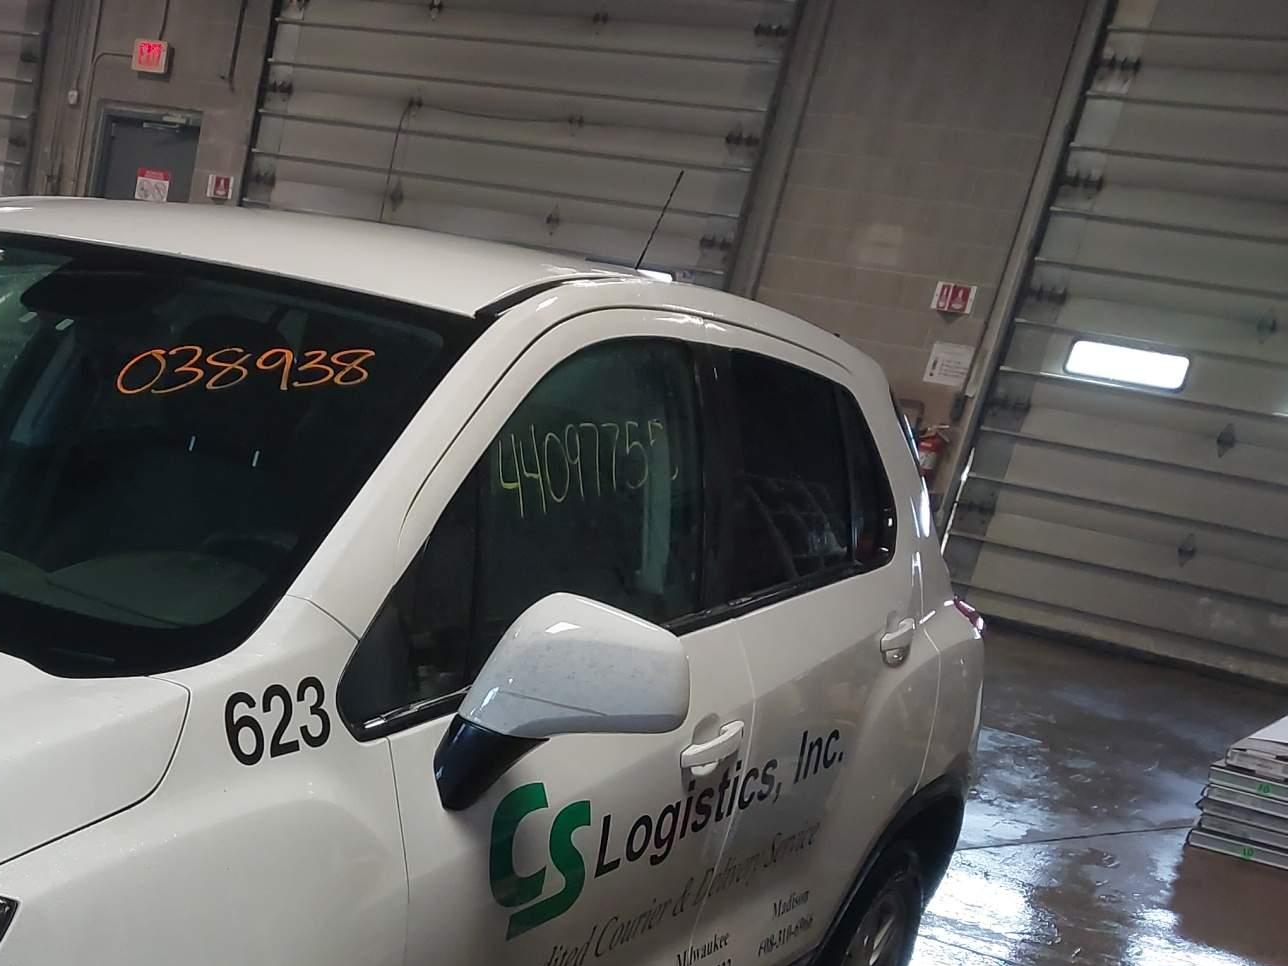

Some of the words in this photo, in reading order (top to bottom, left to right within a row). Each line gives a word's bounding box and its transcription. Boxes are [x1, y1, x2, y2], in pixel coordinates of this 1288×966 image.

[116, 345, 376, 395] 038938
[224, 676, 331, 766] 623
[489, 782, 591, 940] CS
[595, 758, 782, 878] Logistics,
[793, 728, 844, 785] Inc.
[594, 897, 673, 958] Courier
[672, 877, 695, 917] &
[772, 890, 811, 920] Madison
